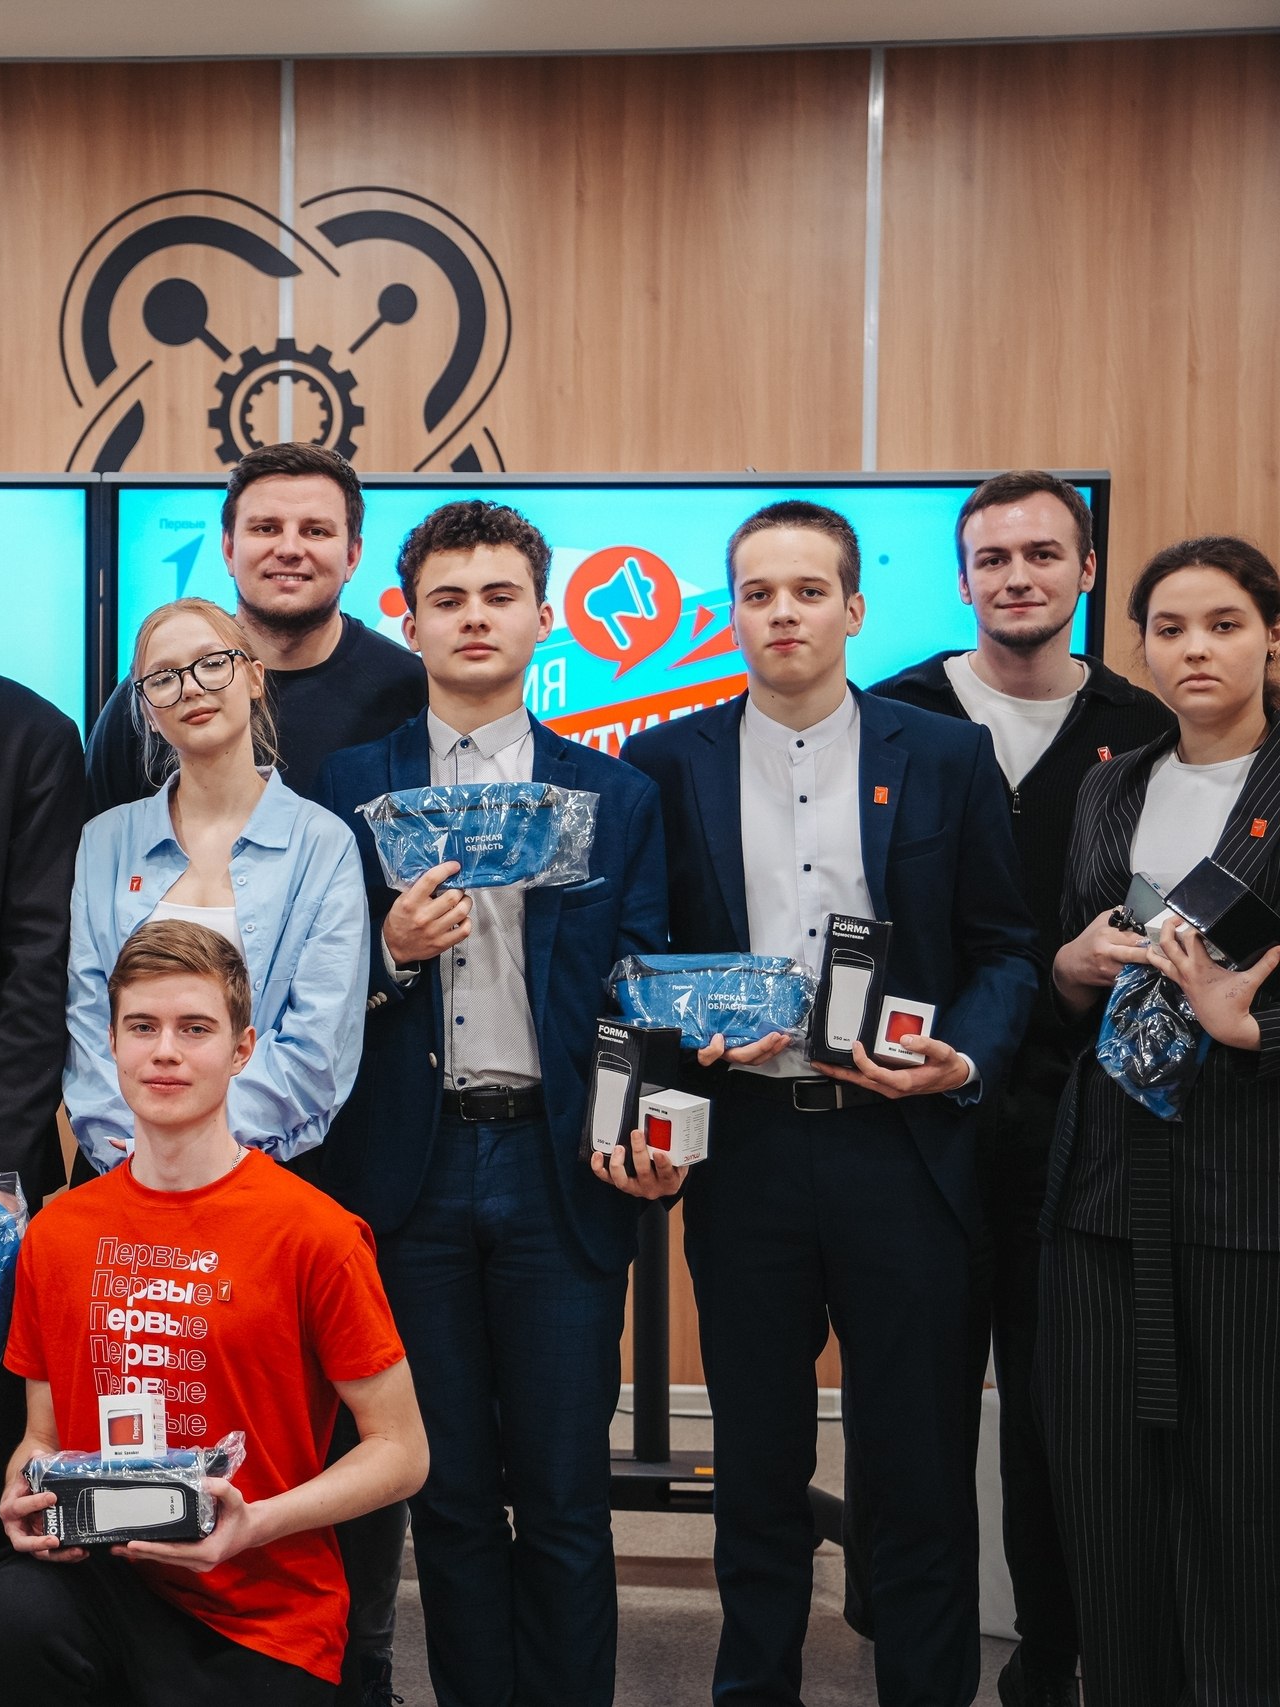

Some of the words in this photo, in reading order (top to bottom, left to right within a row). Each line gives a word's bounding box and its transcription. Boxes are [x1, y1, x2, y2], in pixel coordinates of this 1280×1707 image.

[159, 518, 206, 532] Первые
[464, 834, 503, 843] КУРСКАЯ
[465, 843, 503, 852] ОБЛАСТЬ
[832, 921, 870, 935] FORMA
[832, 930, 865, 940] Термостакан
[708, 993, 747, 1002] КУРСКАЯ
[708, 1002, 747, 1011] ОБЛАСТЬ
[598, 1024, 629, 1040] FORMA
[95, 1236, 219, 1274] Первые
[91, 1269, 213, 1307] Первые
[90, 1302, 208, 1340] Первые
[90, 1334, 207, 1374] Первые
[93, 1367, 207, 1404] Первые
[132, 1415, 141, 1440] Первы
[46, 1503, 58, 1537] ORM
